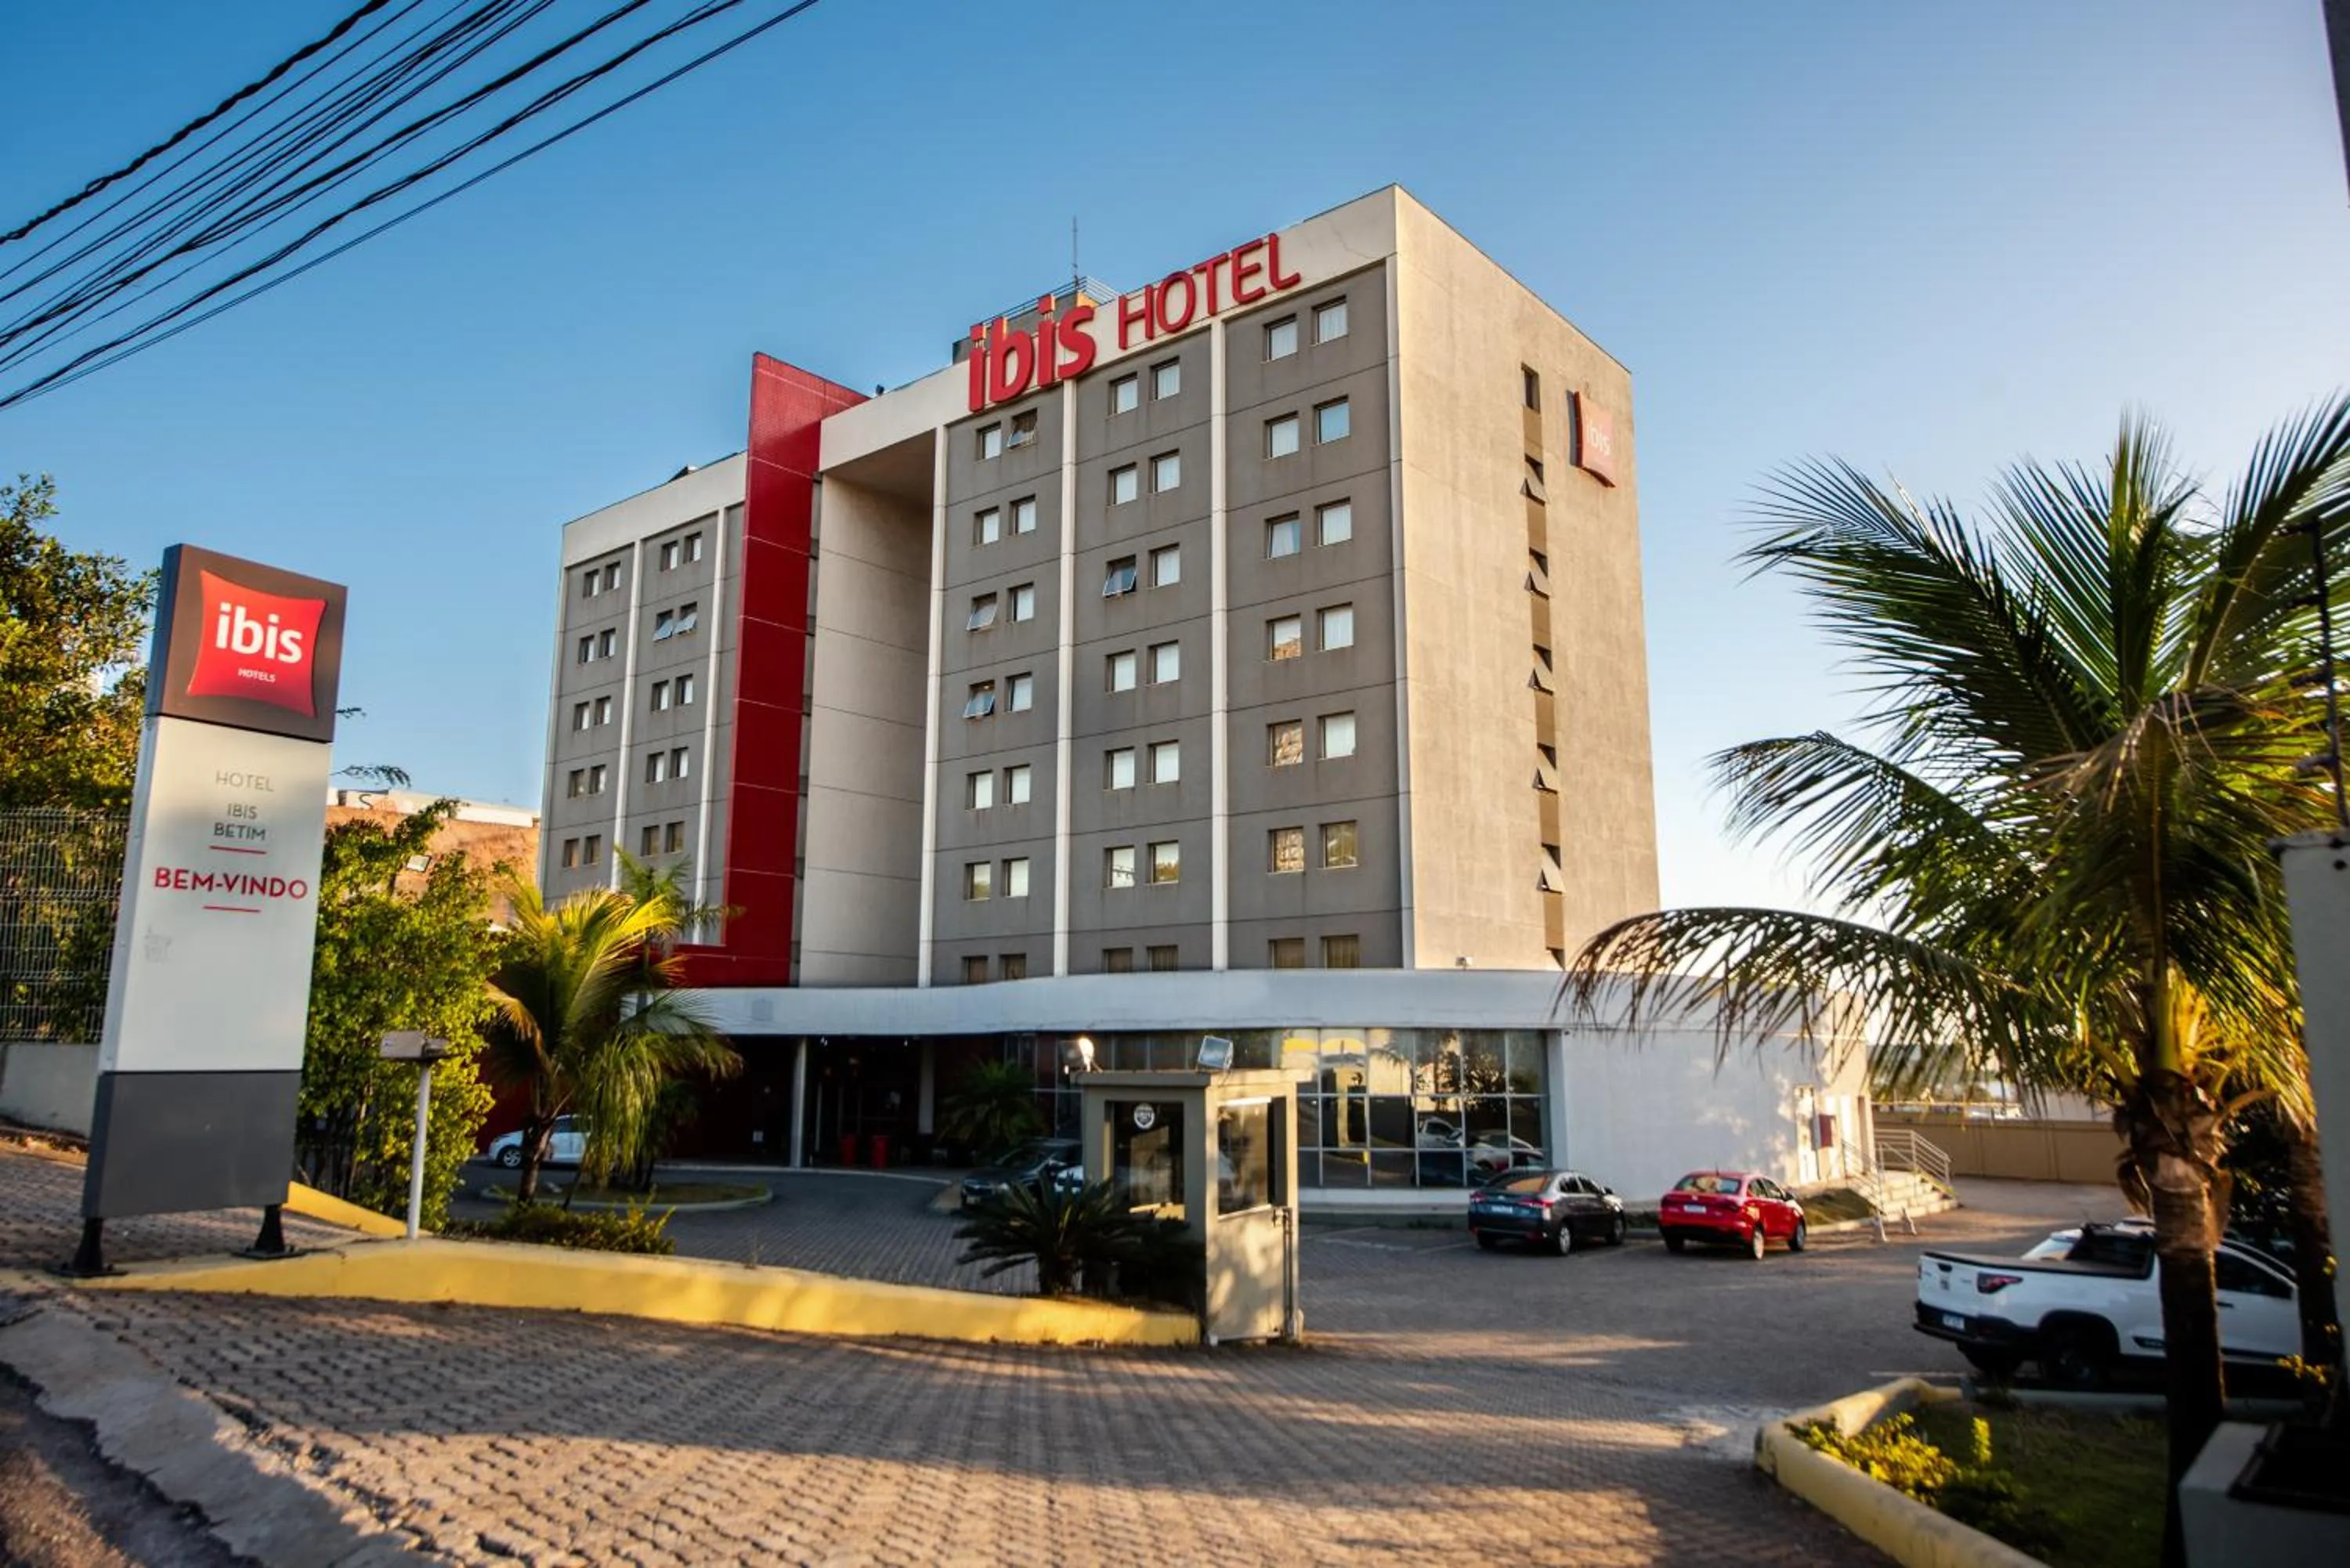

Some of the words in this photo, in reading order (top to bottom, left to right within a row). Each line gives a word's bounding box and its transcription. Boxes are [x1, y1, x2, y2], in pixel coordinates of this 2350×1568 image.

[968, 294, 1095, 413] ibis
[1118, 233, 1301, 350] HOTEL
[216, 602, 302, 663] ibis
[237, 667, 276, 683] HOTELS
[215, 771, 275, 793] HOTEL
[227, 803, 258, 820] IBIS
[214, 822, 266, 841] BETIM
[154, 867, 309, 900] BEM-VINDO
